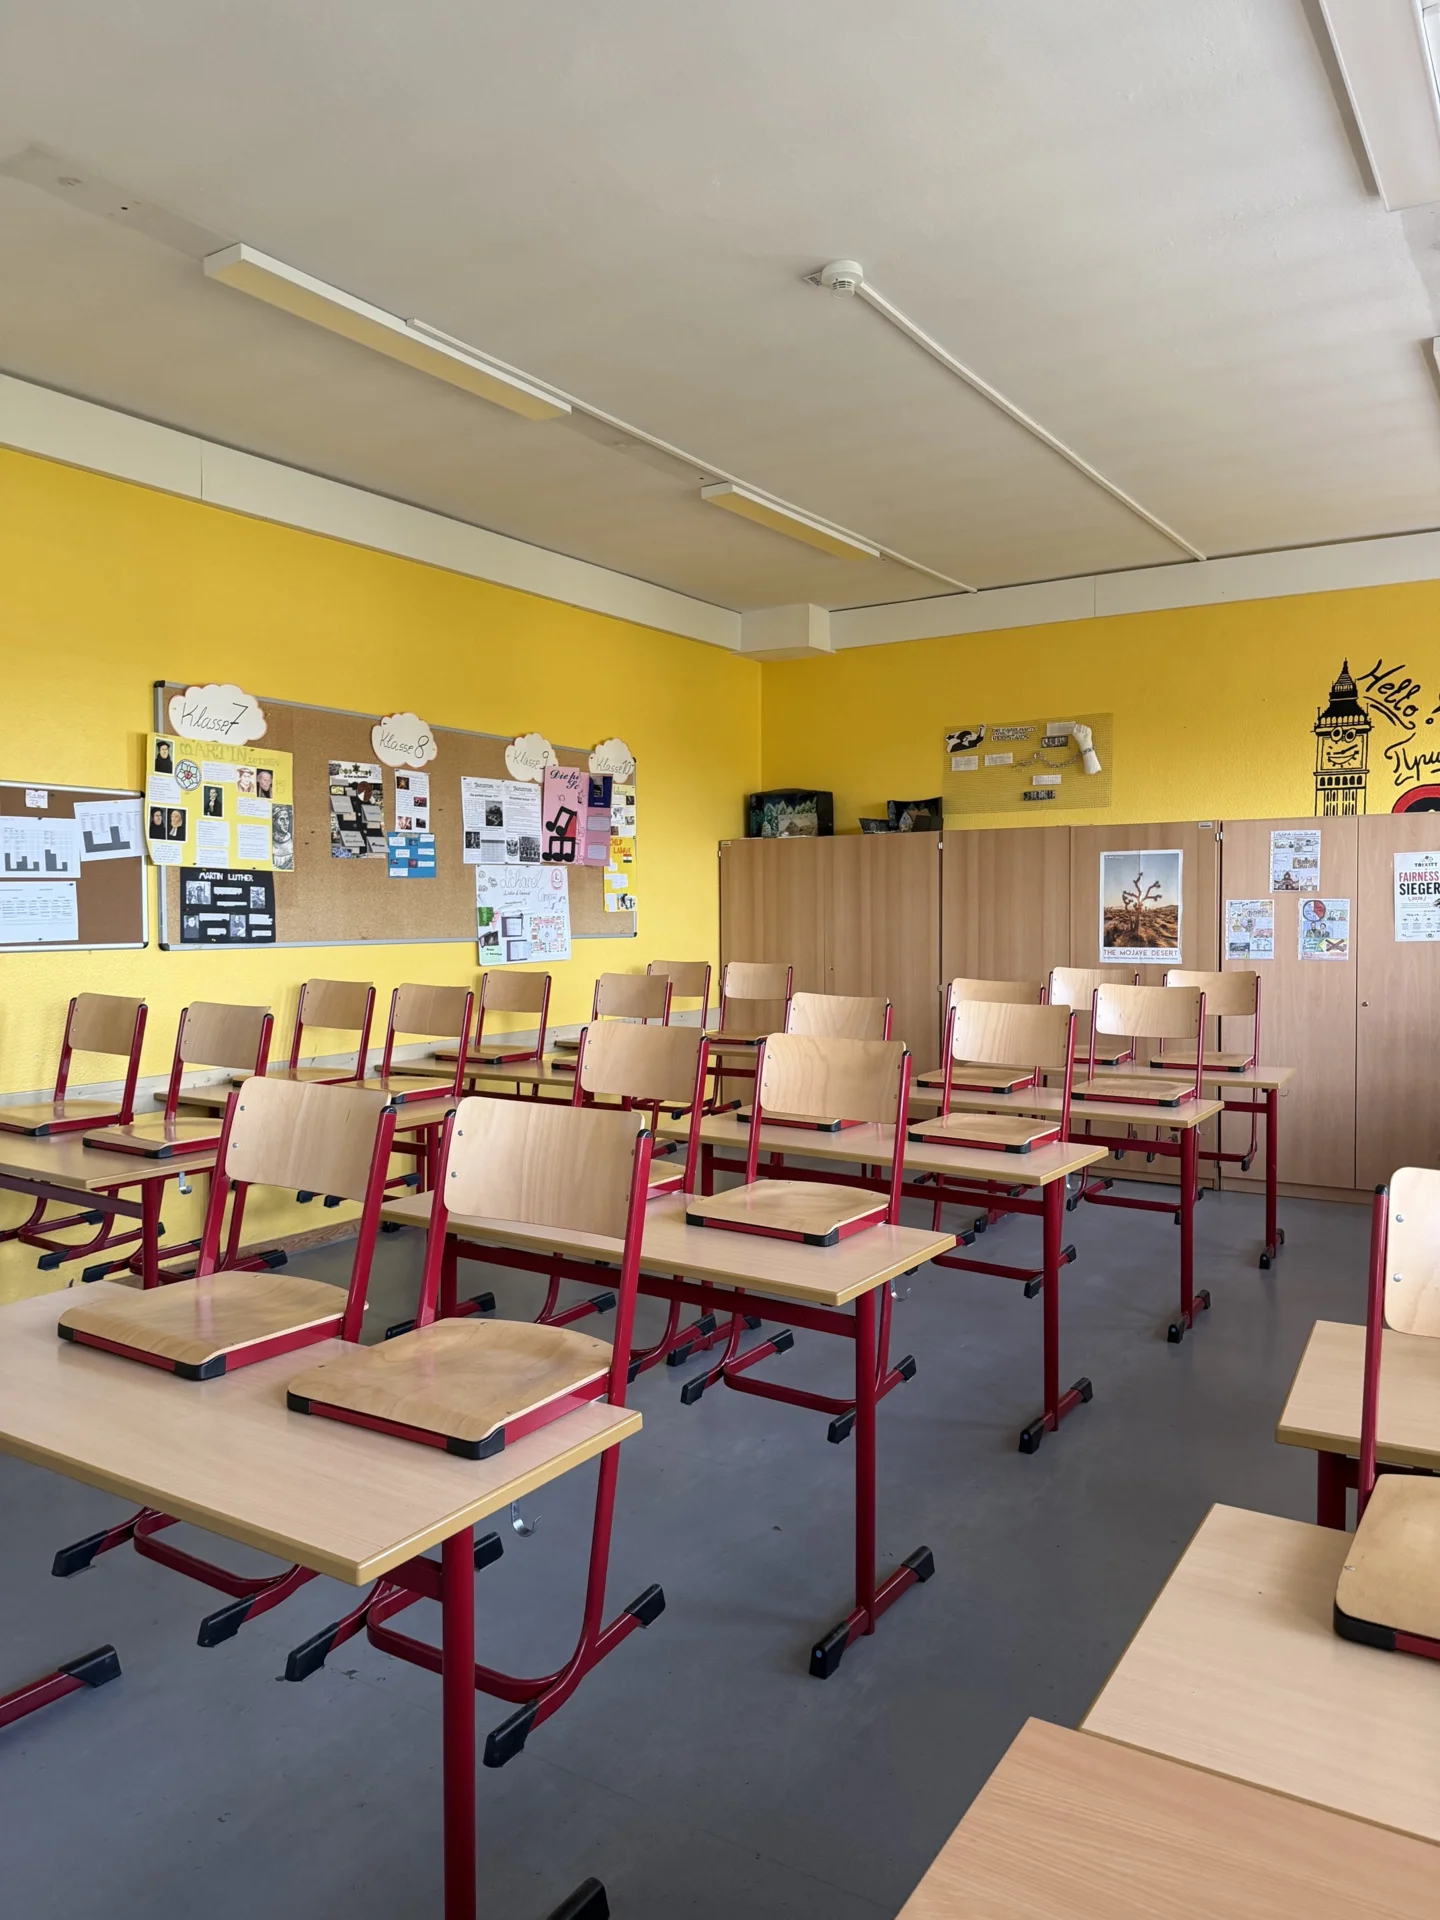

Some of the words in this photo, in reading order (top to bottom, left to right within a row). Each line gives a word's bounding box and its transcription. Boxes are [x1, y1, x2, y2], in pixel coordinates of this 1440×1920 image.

[180, 702, 230, 731] Klasse
[224, 702, 249, 735] 7
[180, 742, 248, 763] MARTIN
[379, 730, 414, 754] Klasse
[414, 735, 430, 759] 8
[514, 750, 541, 770] Klasse
[597, 757, 624, 773] Klasse
[622, 759, 632, 775] 10
[198, 872, 224, 880] MARTIN
[227, 873, 254, 882] LUTHER
[1399, 871, 1440, 882] FAIRNESS
[1399, 882, 1440, 895] SIEGER
